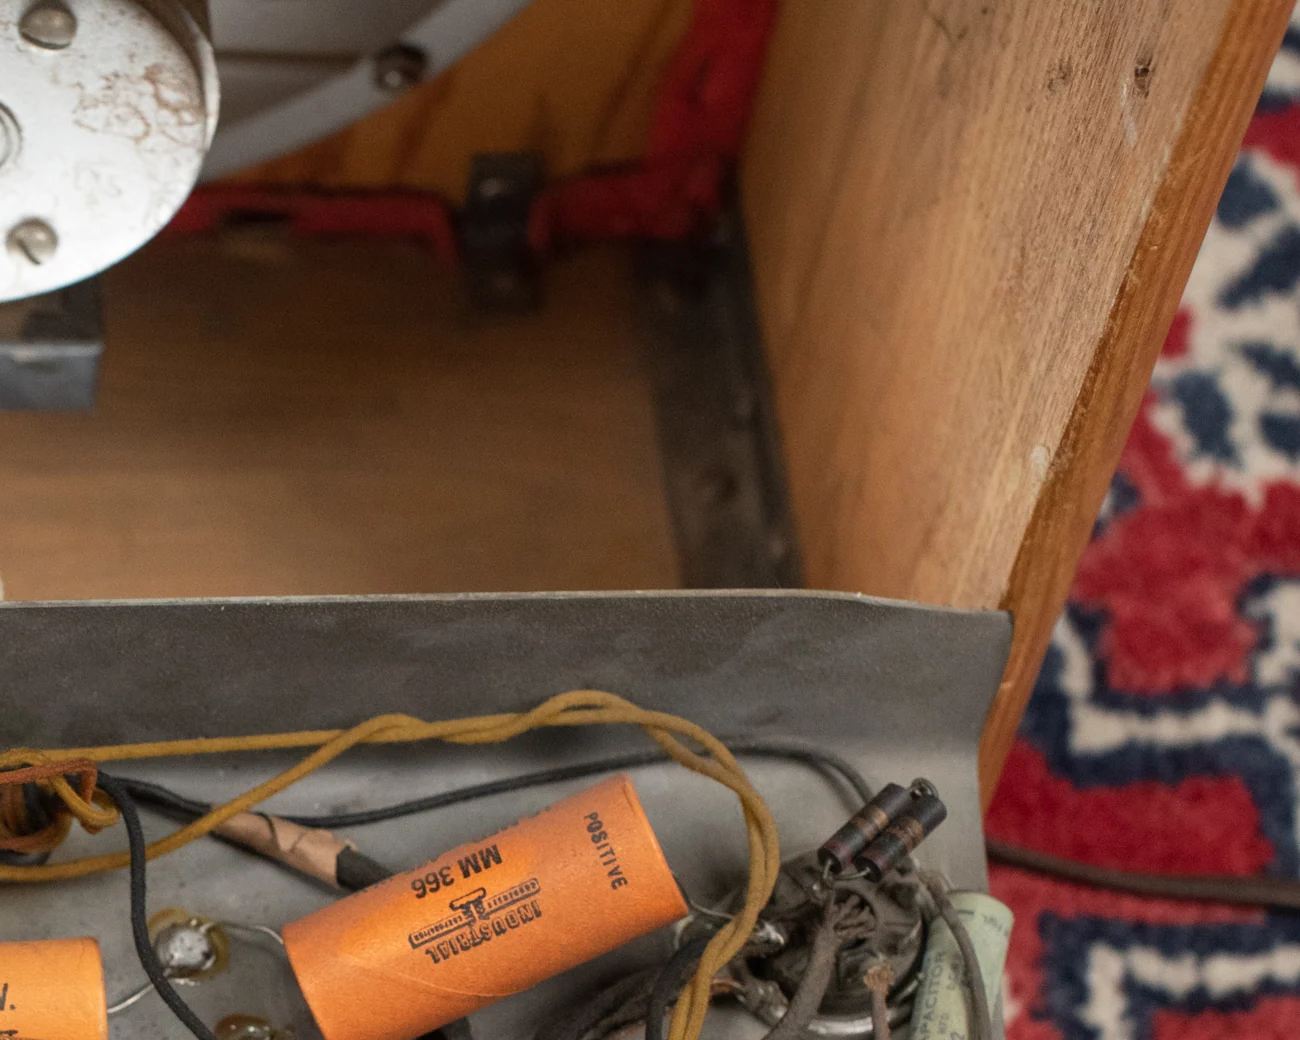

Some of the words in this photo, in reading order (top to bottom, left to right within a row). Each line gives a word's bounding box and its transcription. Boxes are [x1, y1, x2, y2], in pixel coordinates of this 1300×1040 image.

[459, 843, 503, 881] MM
[584, 811, 629, 891] POSITIVE
[410, 863, 456, 899] 366
[424, 898, 543, 965] INDUSTRIAL
